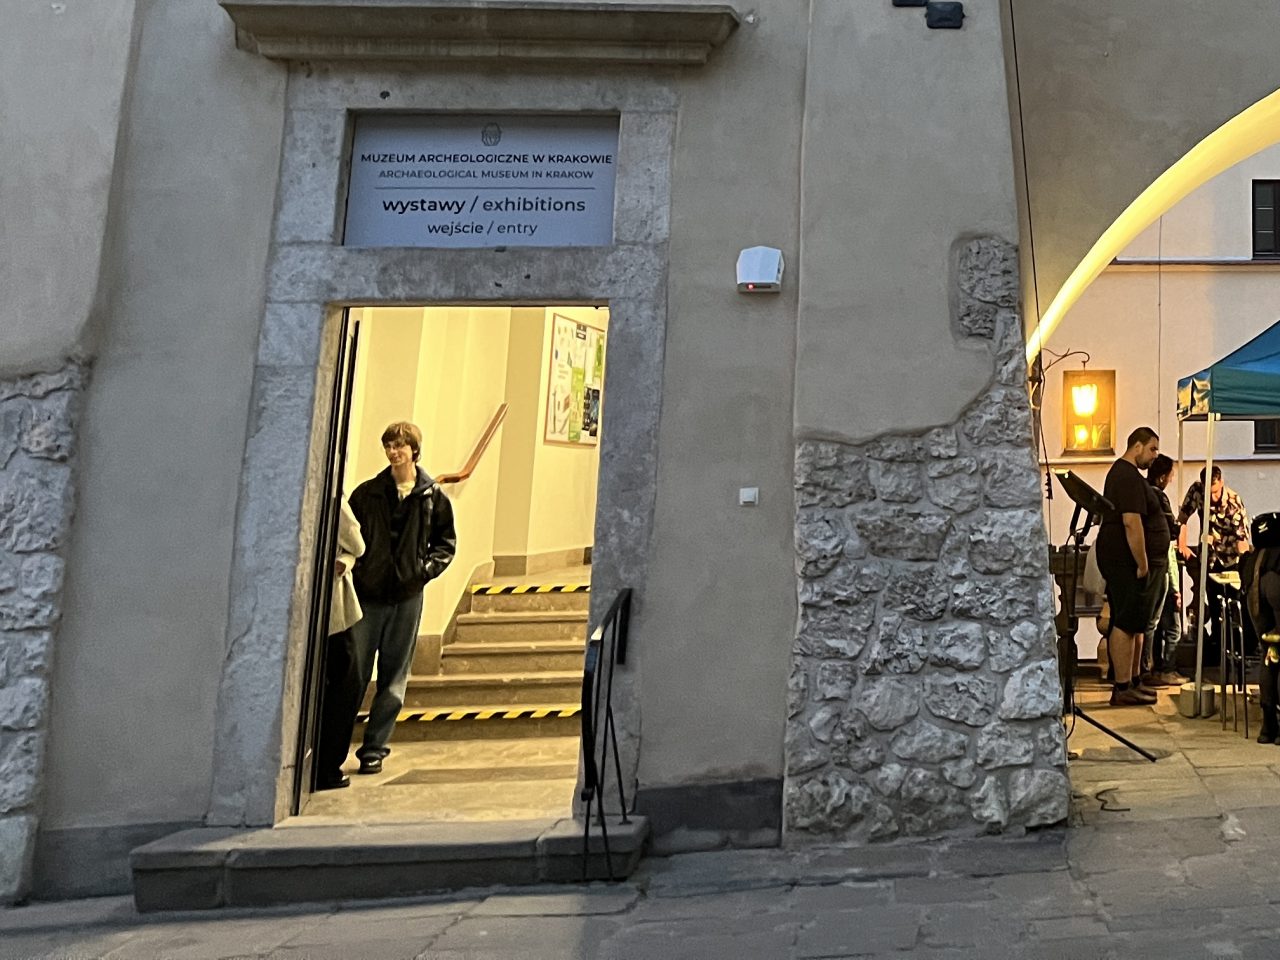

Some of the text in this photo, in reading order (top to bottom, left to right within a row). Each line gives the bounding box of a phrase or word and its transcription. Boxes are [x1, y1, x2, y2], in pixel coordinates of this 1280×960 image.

[360, 153, 613, 164] MUZEUM ARCHEOLOGICZNE W KRAKOWIE
[379, 169, 478, 179] ARCHAEOLOGICAL
[481, 170, 529, 179] MUSEUM
[531, 170, 543, 179] IN
[382, 195, 586, 215] wystawy / exhibitions
[427, 221, 538, 237] wejście / entry
